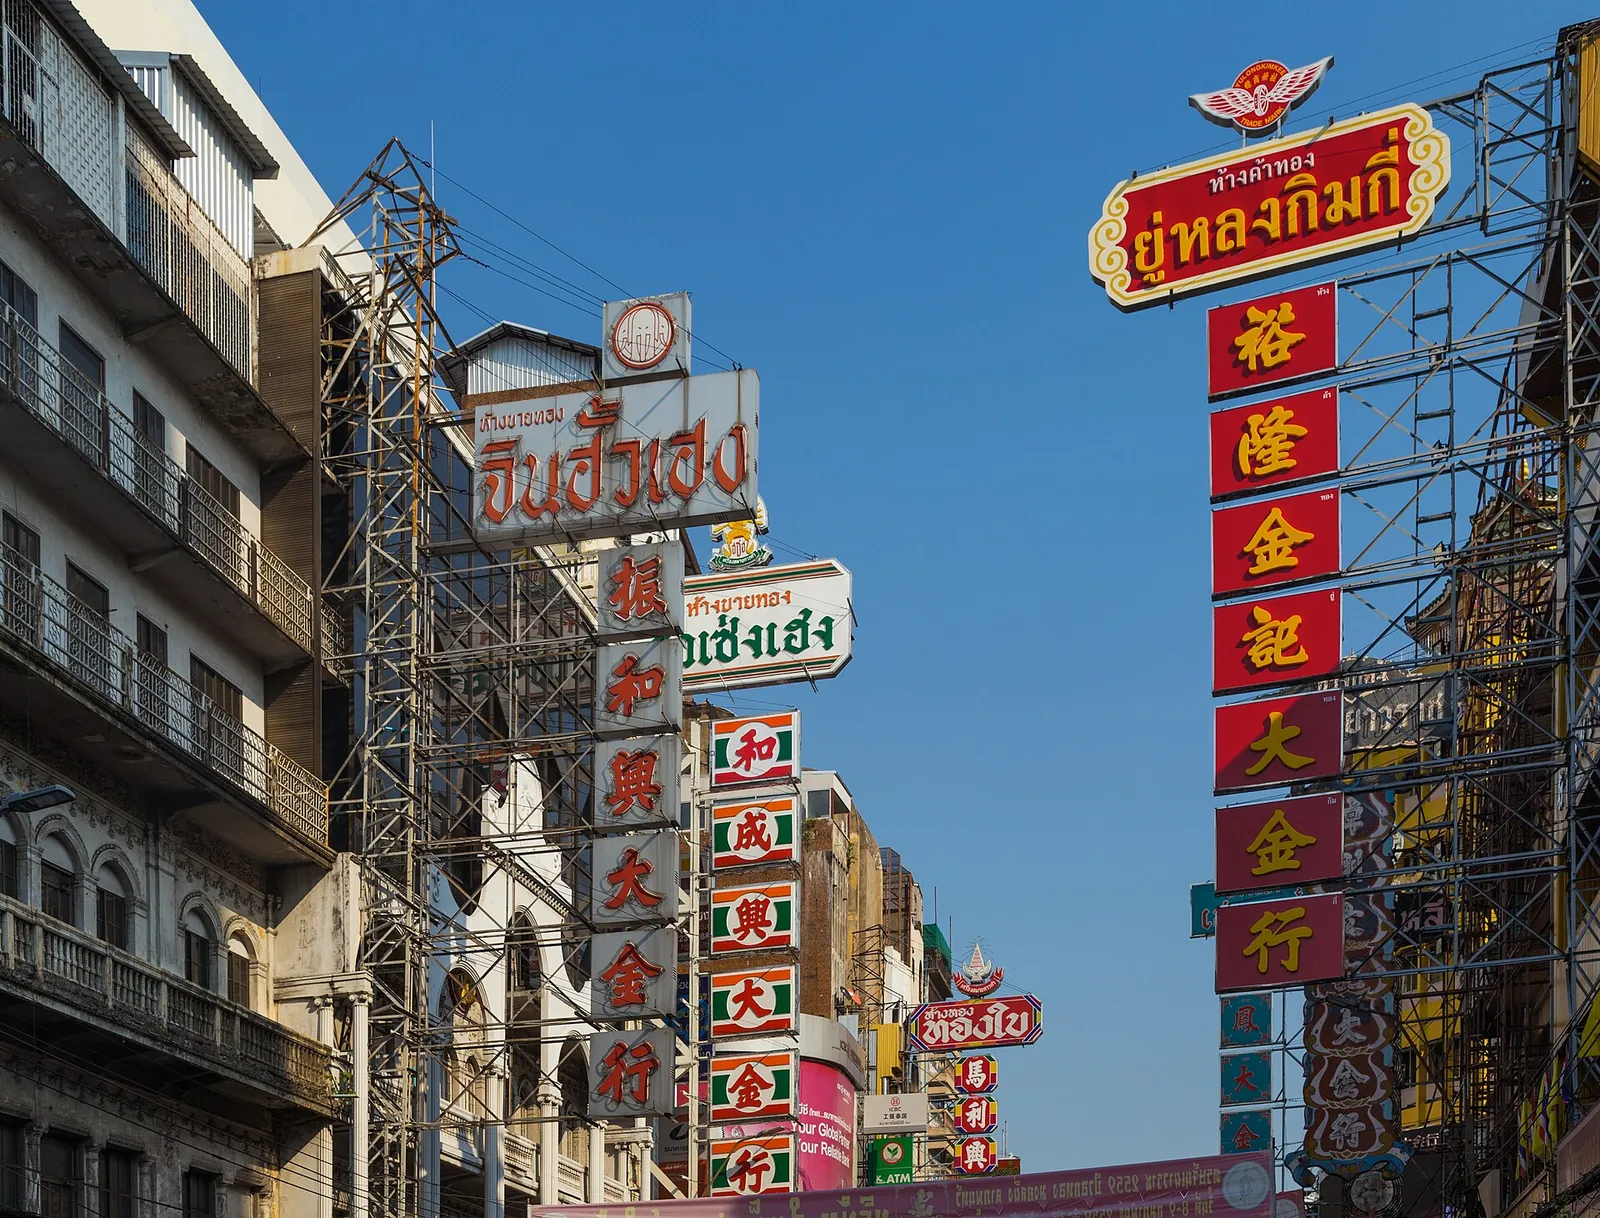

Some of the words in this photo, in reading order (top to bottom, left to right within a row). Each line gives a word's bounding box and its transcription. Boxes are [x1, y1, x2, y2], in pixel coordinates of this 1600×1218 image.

[1234, 62, 1287, 87] YULONGKIMKEE
[1240, 117, 1262, 127] TRADE
[1264, 106, 1285, 124] MARK
[1209, 152, 1316, 193] ห้างค้าทอง
[1134, 127, 1401, 284] ยู่หลงกิมกี่
[480, 406, 565, 432] ห้างขายทอง
[1243, 506, 1315, 575] 金
[686, 588, 793, 618] ห้างขายทอง
[682, 607, 835, 669] วเซ่งเฮง
[608, 655, 666, 718] 和
[732, 728, 777, 772] 和
[1244, 711, 1316, 776] 大
[1246, 808, 1317, 876] 金
[604, 847, 664, 910] 大
[1242, 906, 1314, 974] 行
[599, 940, 664, 1009] 金
[731, 978, 774, 1022] 大
[924, 1006, 975, 1020] ห้างทอง
[922, 1002, 1030, 1045] ทองใบ
[598, 1040, 660, 1103] 行
[728, 1063, 775, 1110] 金
[966, 1060, 987, 1088] 馬
[790, 1120, 816, 1135] Your
[818, 1122, 839, 1142] Global
[966, 1100, 987, 1129] 利
[799, 1138, 818, 1154] our
